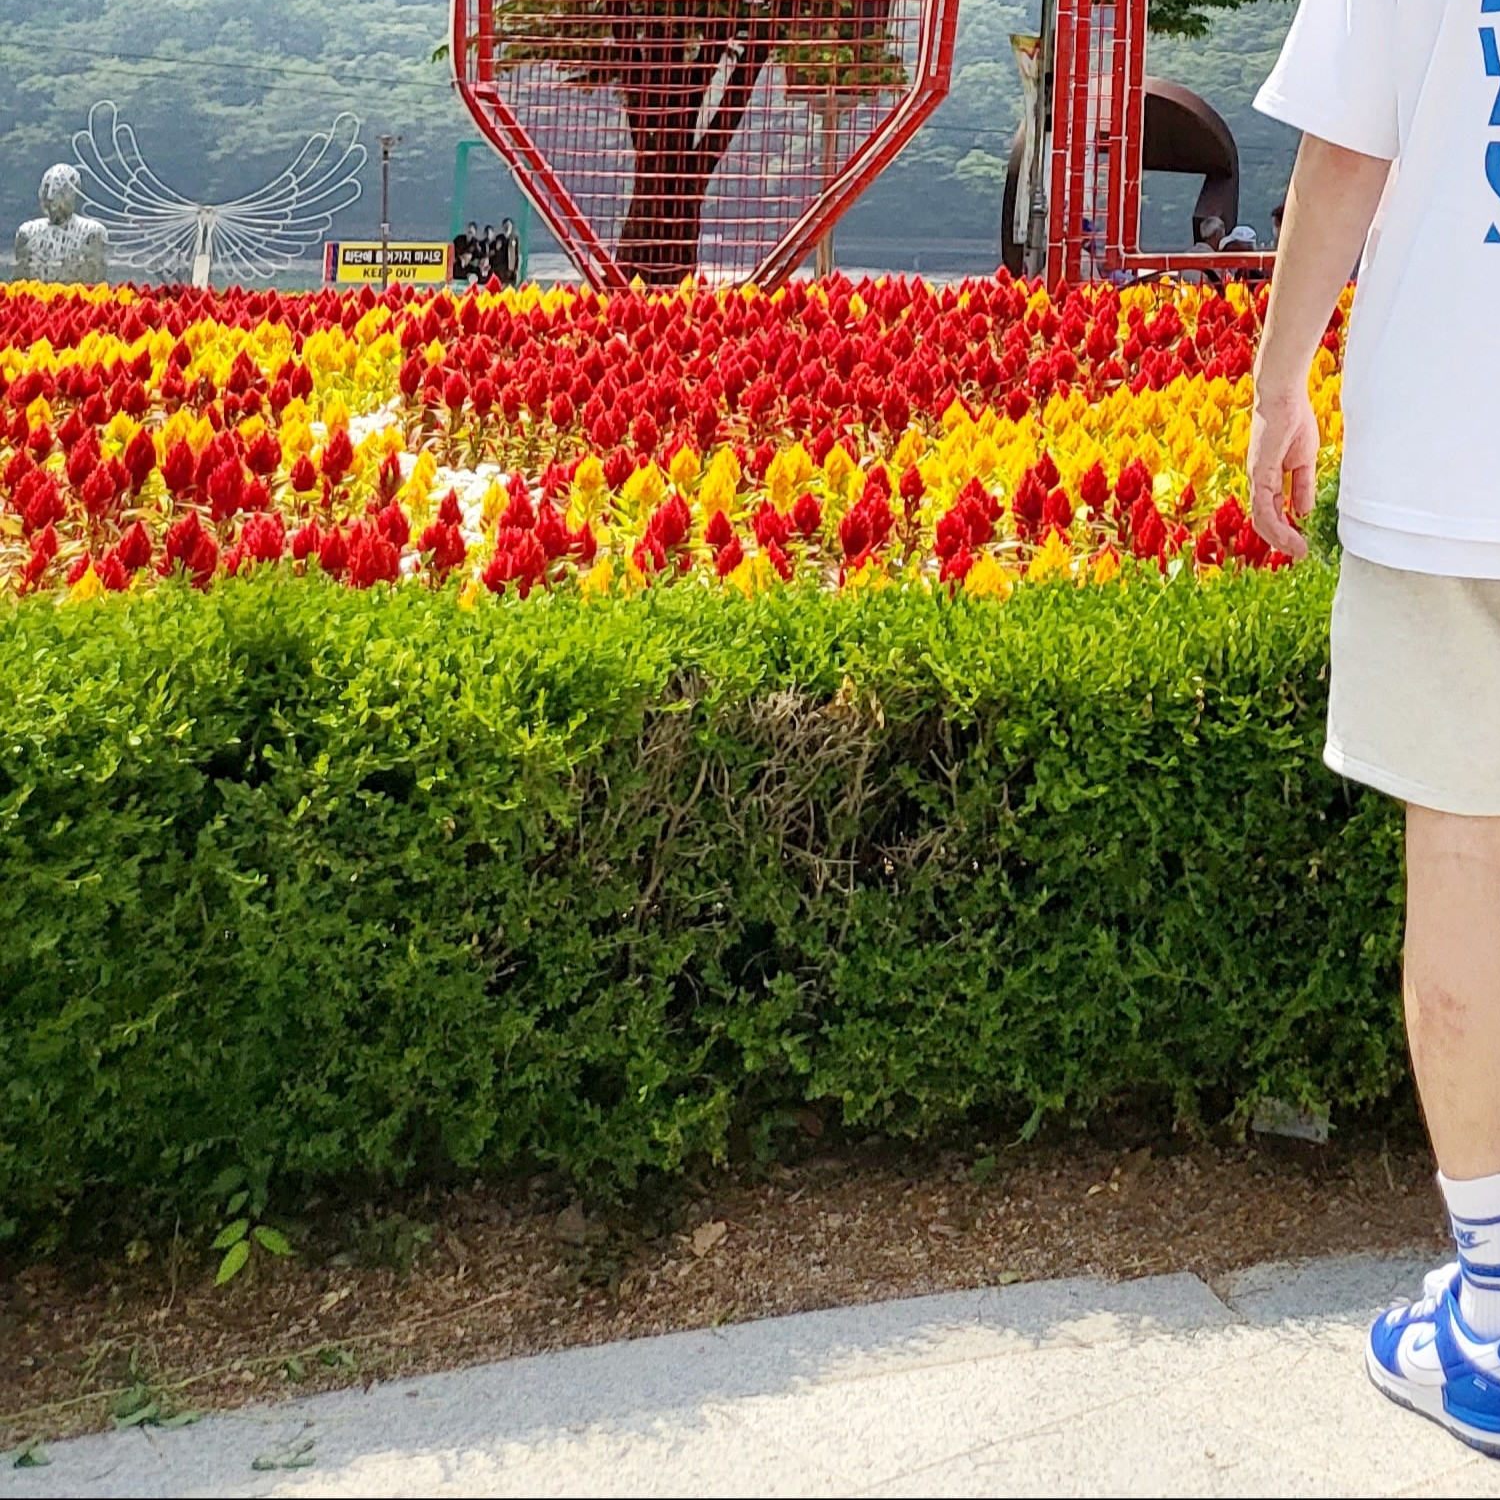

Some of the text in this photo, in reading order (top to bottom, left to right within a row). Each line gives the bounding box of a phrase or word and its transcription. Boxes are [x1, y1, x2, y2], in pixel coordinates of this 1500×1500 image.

[344, 249, 373, 264] 화단에
[414, 249, 442, 263] 마시오
[363, 267, 418, 278] KEEP OUT
